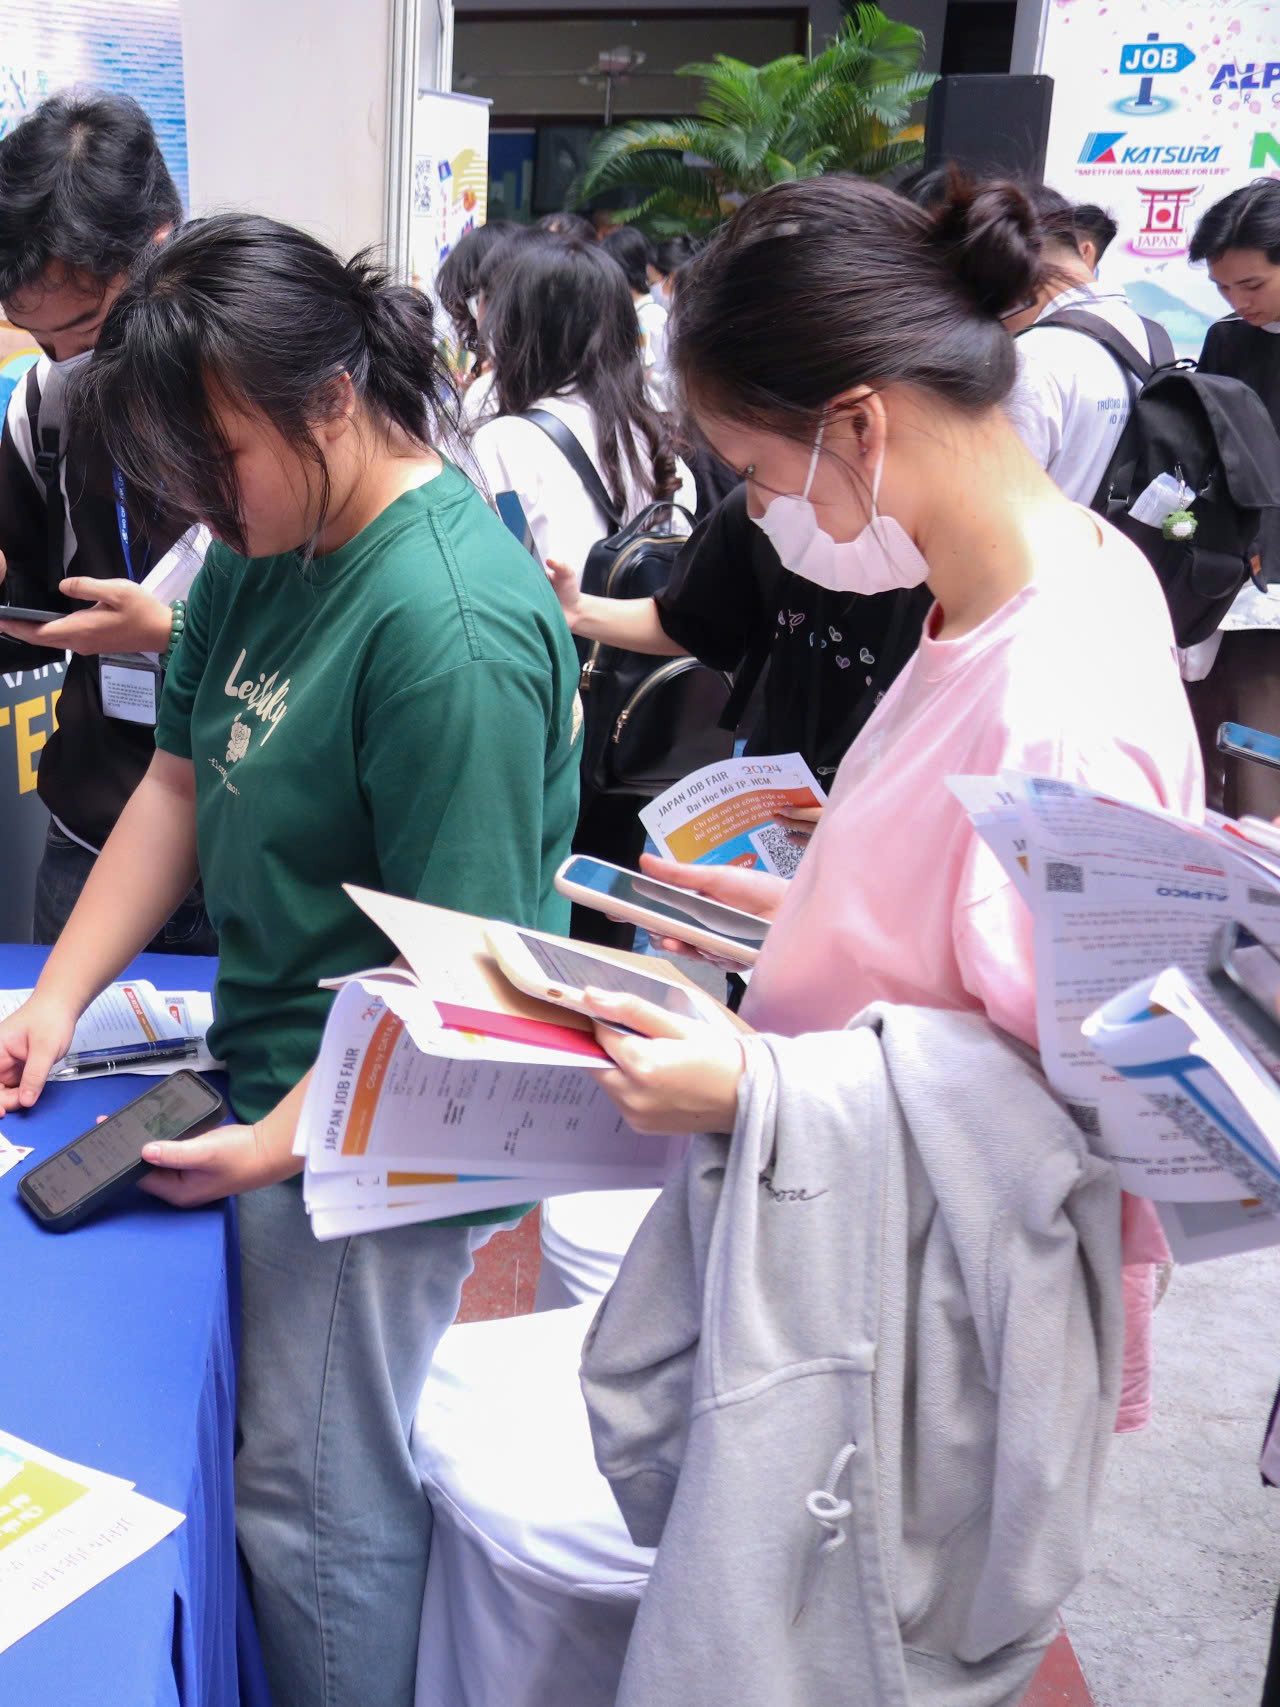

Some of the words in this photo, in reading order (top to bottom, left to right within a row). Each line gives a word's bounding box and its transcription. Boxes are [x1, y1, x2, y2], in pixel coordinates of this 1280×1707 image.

[1125, 48, 1179, 70] JOB
[1121, 144, 1223, 164] KATSURA
[1108, 168, 1122, 176] FOR
[1124, 168, 1143, 177] GAS,
[1144, 167, 1190, 176] ASSURANCE
[1192, 167, 1208, 176] FOR
[1136, 235, 1179, 249] JAPAN
[658, 792, 686, 817] JAPAN
[686, 781, 705, 798] JOB
[705, 771, 729, 787] FAIR
[741, 763, 782, 776] 2024
[752, 776, 772, 787] HCM
[340, 1047, 360, 1077] FAIR
[335, 1077, 351, 1106] JOB
[325, 1109, 345, 1151] JAPAN
